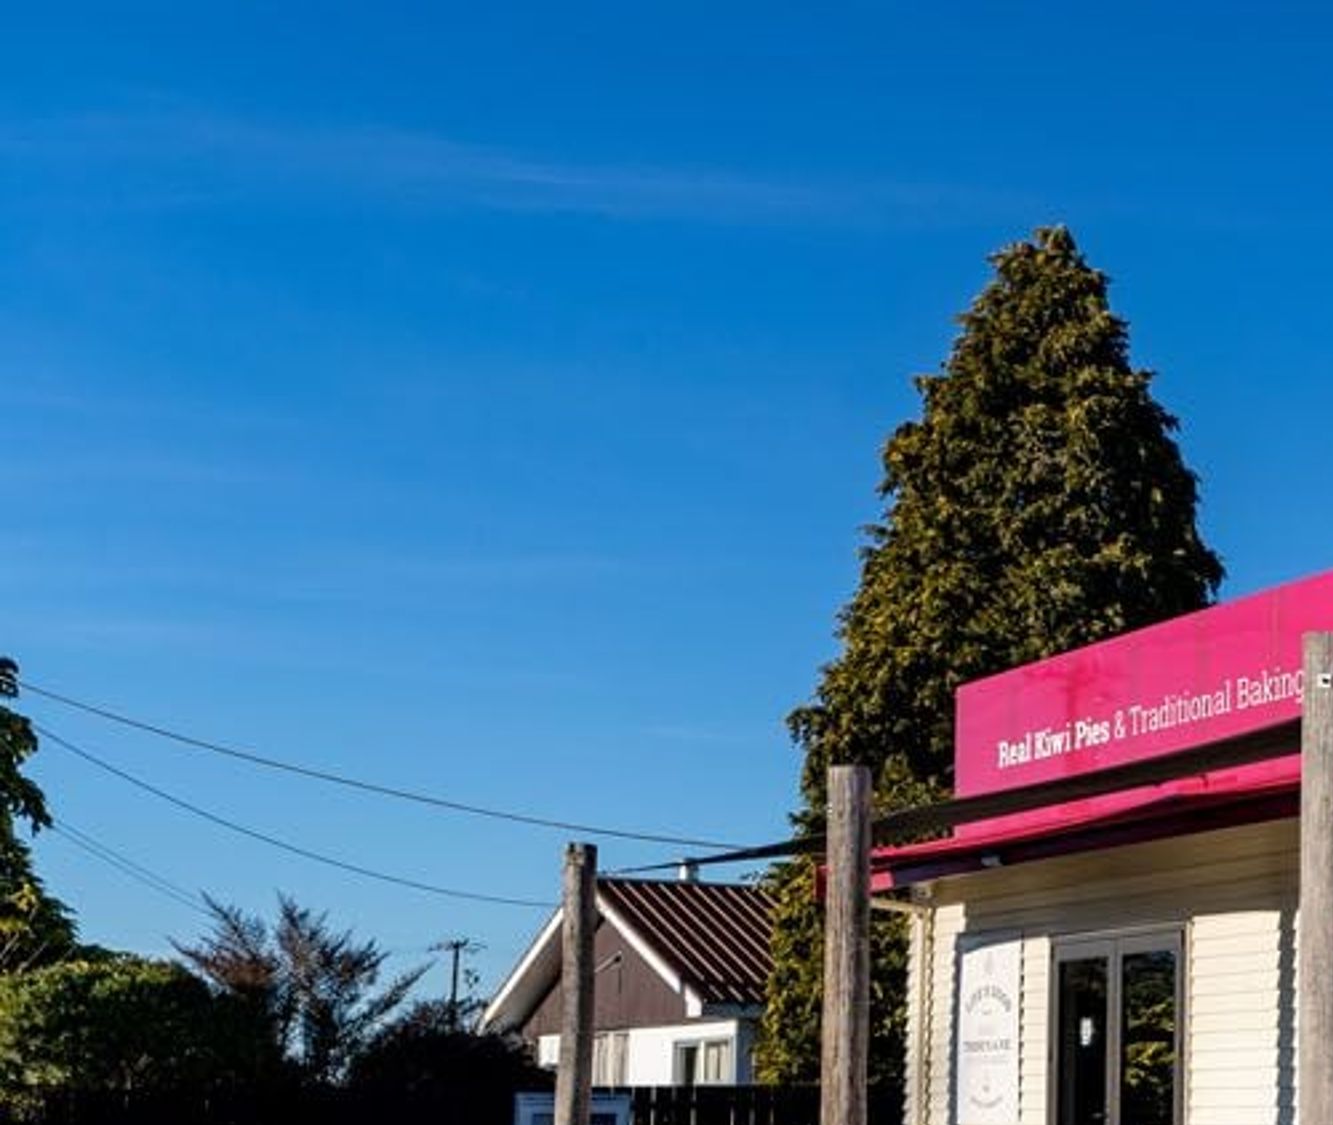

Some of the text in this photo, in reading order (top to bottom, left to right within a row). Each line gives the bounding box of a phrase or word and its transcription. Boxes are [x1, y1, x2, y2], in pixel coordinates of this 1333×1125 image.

[998, 667, 1304, 768] Real Kiwi Pies & Traditional Baking
